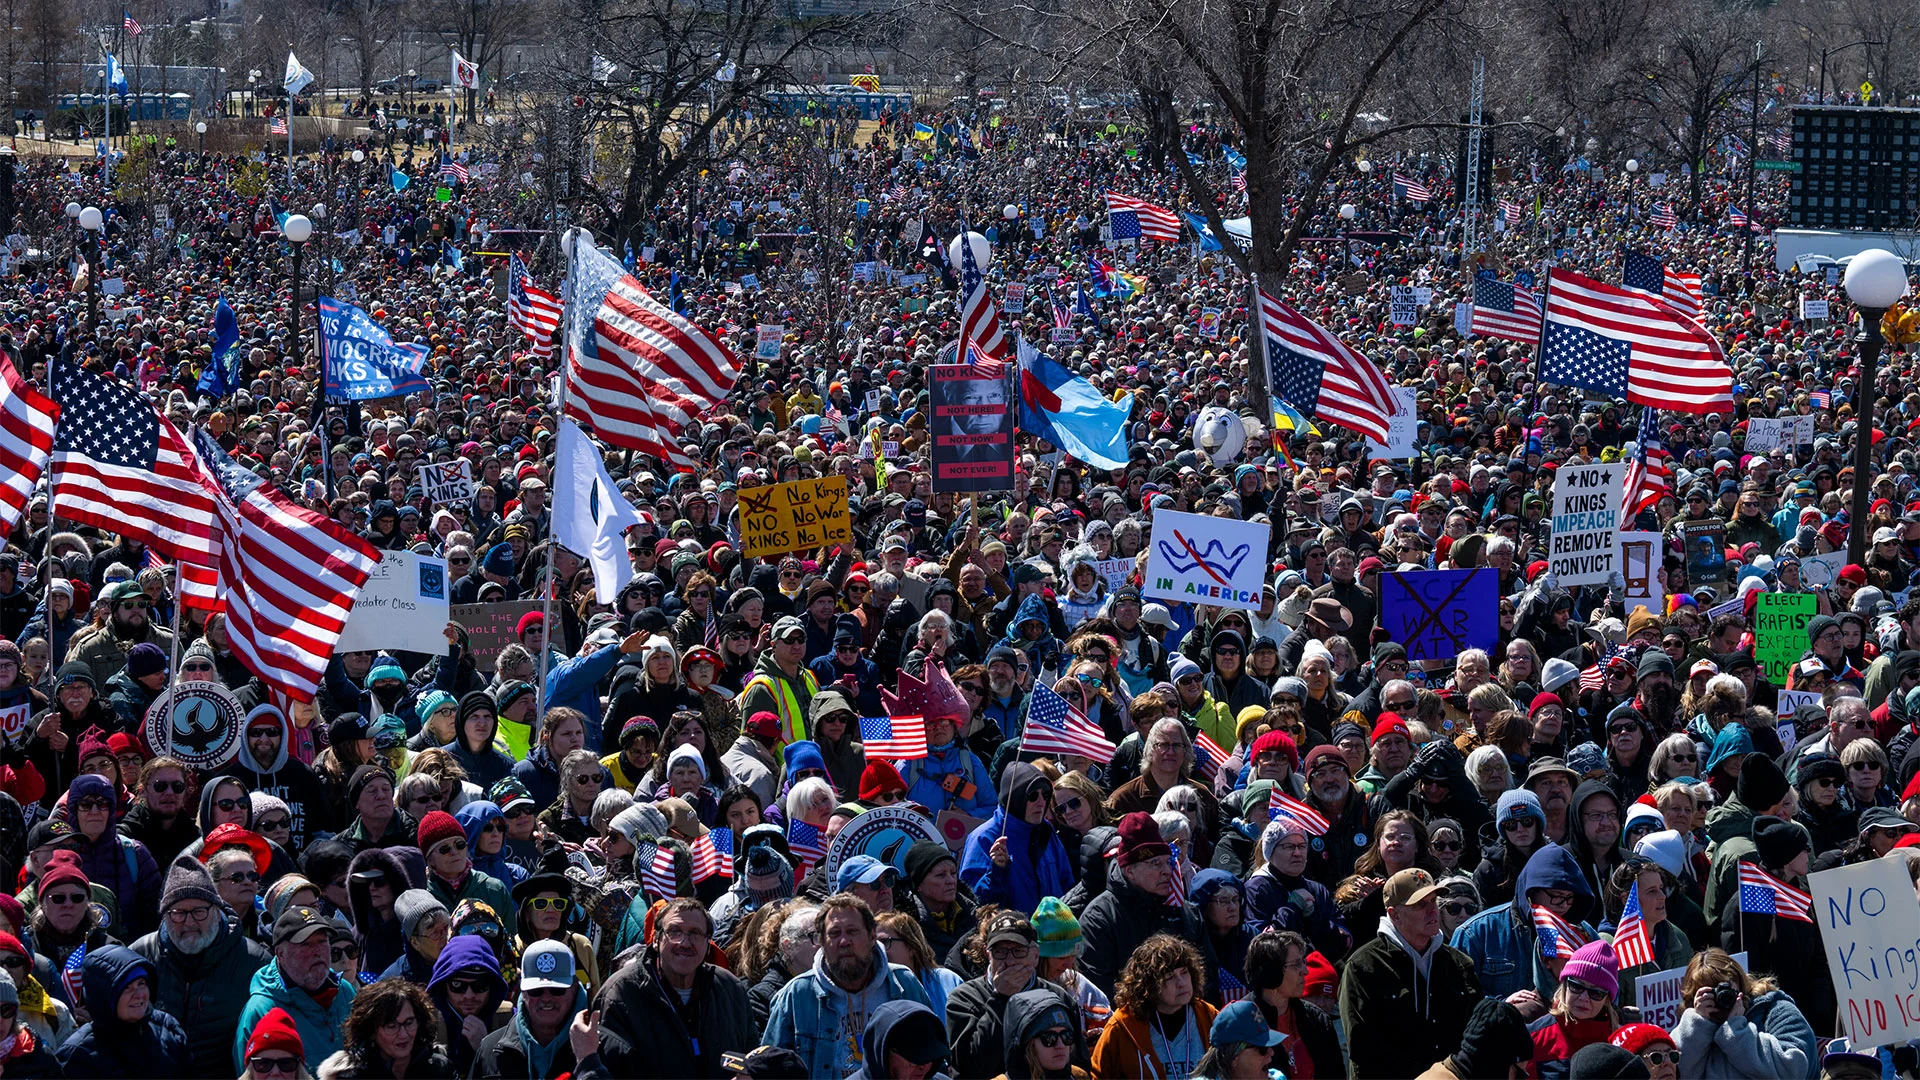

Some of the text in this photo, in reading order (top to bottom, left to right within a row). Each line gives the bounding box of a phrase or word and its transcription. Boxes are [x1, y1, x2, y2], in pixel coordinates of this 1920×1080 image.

[1396, 285, 1412, 294] NO
[1391, 295, 1416, 303] KINGS
[1392, 303, 1416, 311] SINCE
[1394, 312, 1415, 321] 1776
[937, 366, 1005, 378] NO KIS!
[1749, 420, 1760, 435] Due
[970, 434, 993, 442] NOW!
[1745, 436, 1771, 450] Google
[424, 463, 462, 487] NO
[1579, 470, 1599, 488] NO
[427, 482, 470, 502] KINGS
[787, 482, 845, 505] No Kings
[1564, 493, 1607, 514] KINGS
[792, 504, 844, 524] No War
[1552, 510, 1616, 533] IMPEACH
[747, 514, 778, 532] NO
[1686, 525, 1710, 534] JUSTICE
[749, 531, 789, 550] KINGS
[797, 525, 846, 545] No Ice
[1554, 531, 1613, 554] REMOVE
[388, 553, 404, 567] the
[1099, 560, 1130, 575] FELON
[1552, 554, 1613, 577] CONVICT
[1156, 578, 1260, 604] IN AMERICA
[1395, 578, 1467, 602] ICE
[391, 597, 417, 611] Class
[1765, 595, 1803, 606] ELECT
[453, 607, 481, 616] 1938
[490, 613, 512, 621] THE
[464, 626, 497, 634] HOLE
[1402, 609, 1469, 636] WAR
[1758, 613, 1816, 631] RAPIST
[497, 636, 511, 644] IS
[1757, 634, 1809, 650] EXPECT
[1786, 694, 1813, 711] NO
[1780, 729, 1790, 740] in
[205, 756, 226, 769] ALL
[866, 809, 926, 827] JUSTICE
[831, 833, 848, 893] REEDOM
[1829, 887, 1886, 929] NO
[1848, 993, 1920, 1044] NO IC
